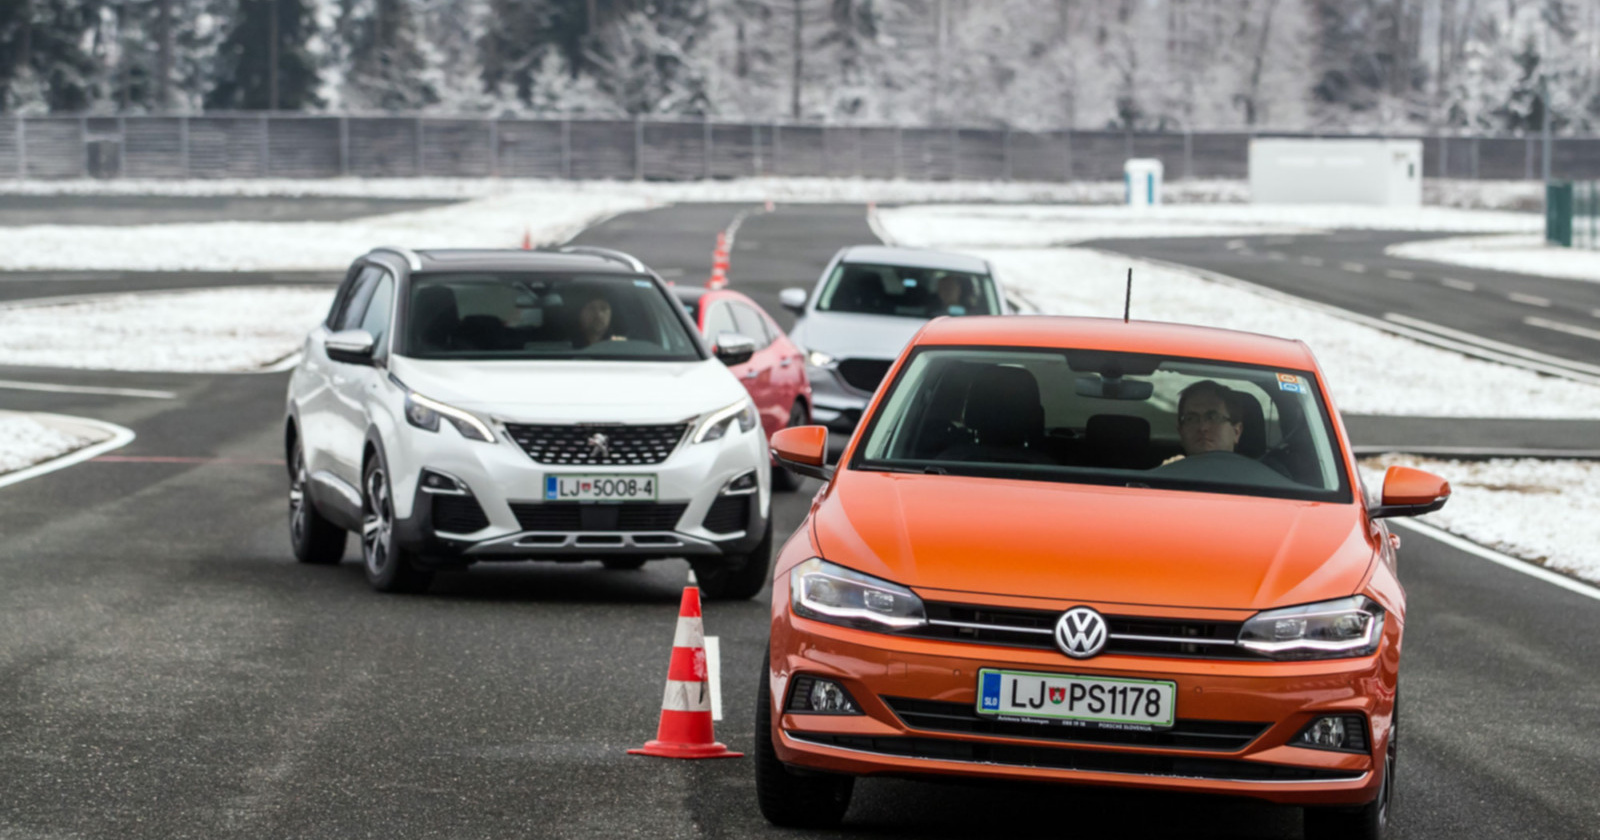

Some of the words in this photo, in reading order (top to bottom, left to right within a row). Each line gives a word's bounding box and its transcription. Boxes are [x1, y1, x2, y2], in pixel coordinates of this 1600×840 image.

[560, 480, 580, 497] LJ
[593, 479, 652, 497] 5008-4
[1056, 608, 1106, 657] VW
[1011, 679, 1046, 709] LJ
[1069, 683, 1161, 717] PS1178
